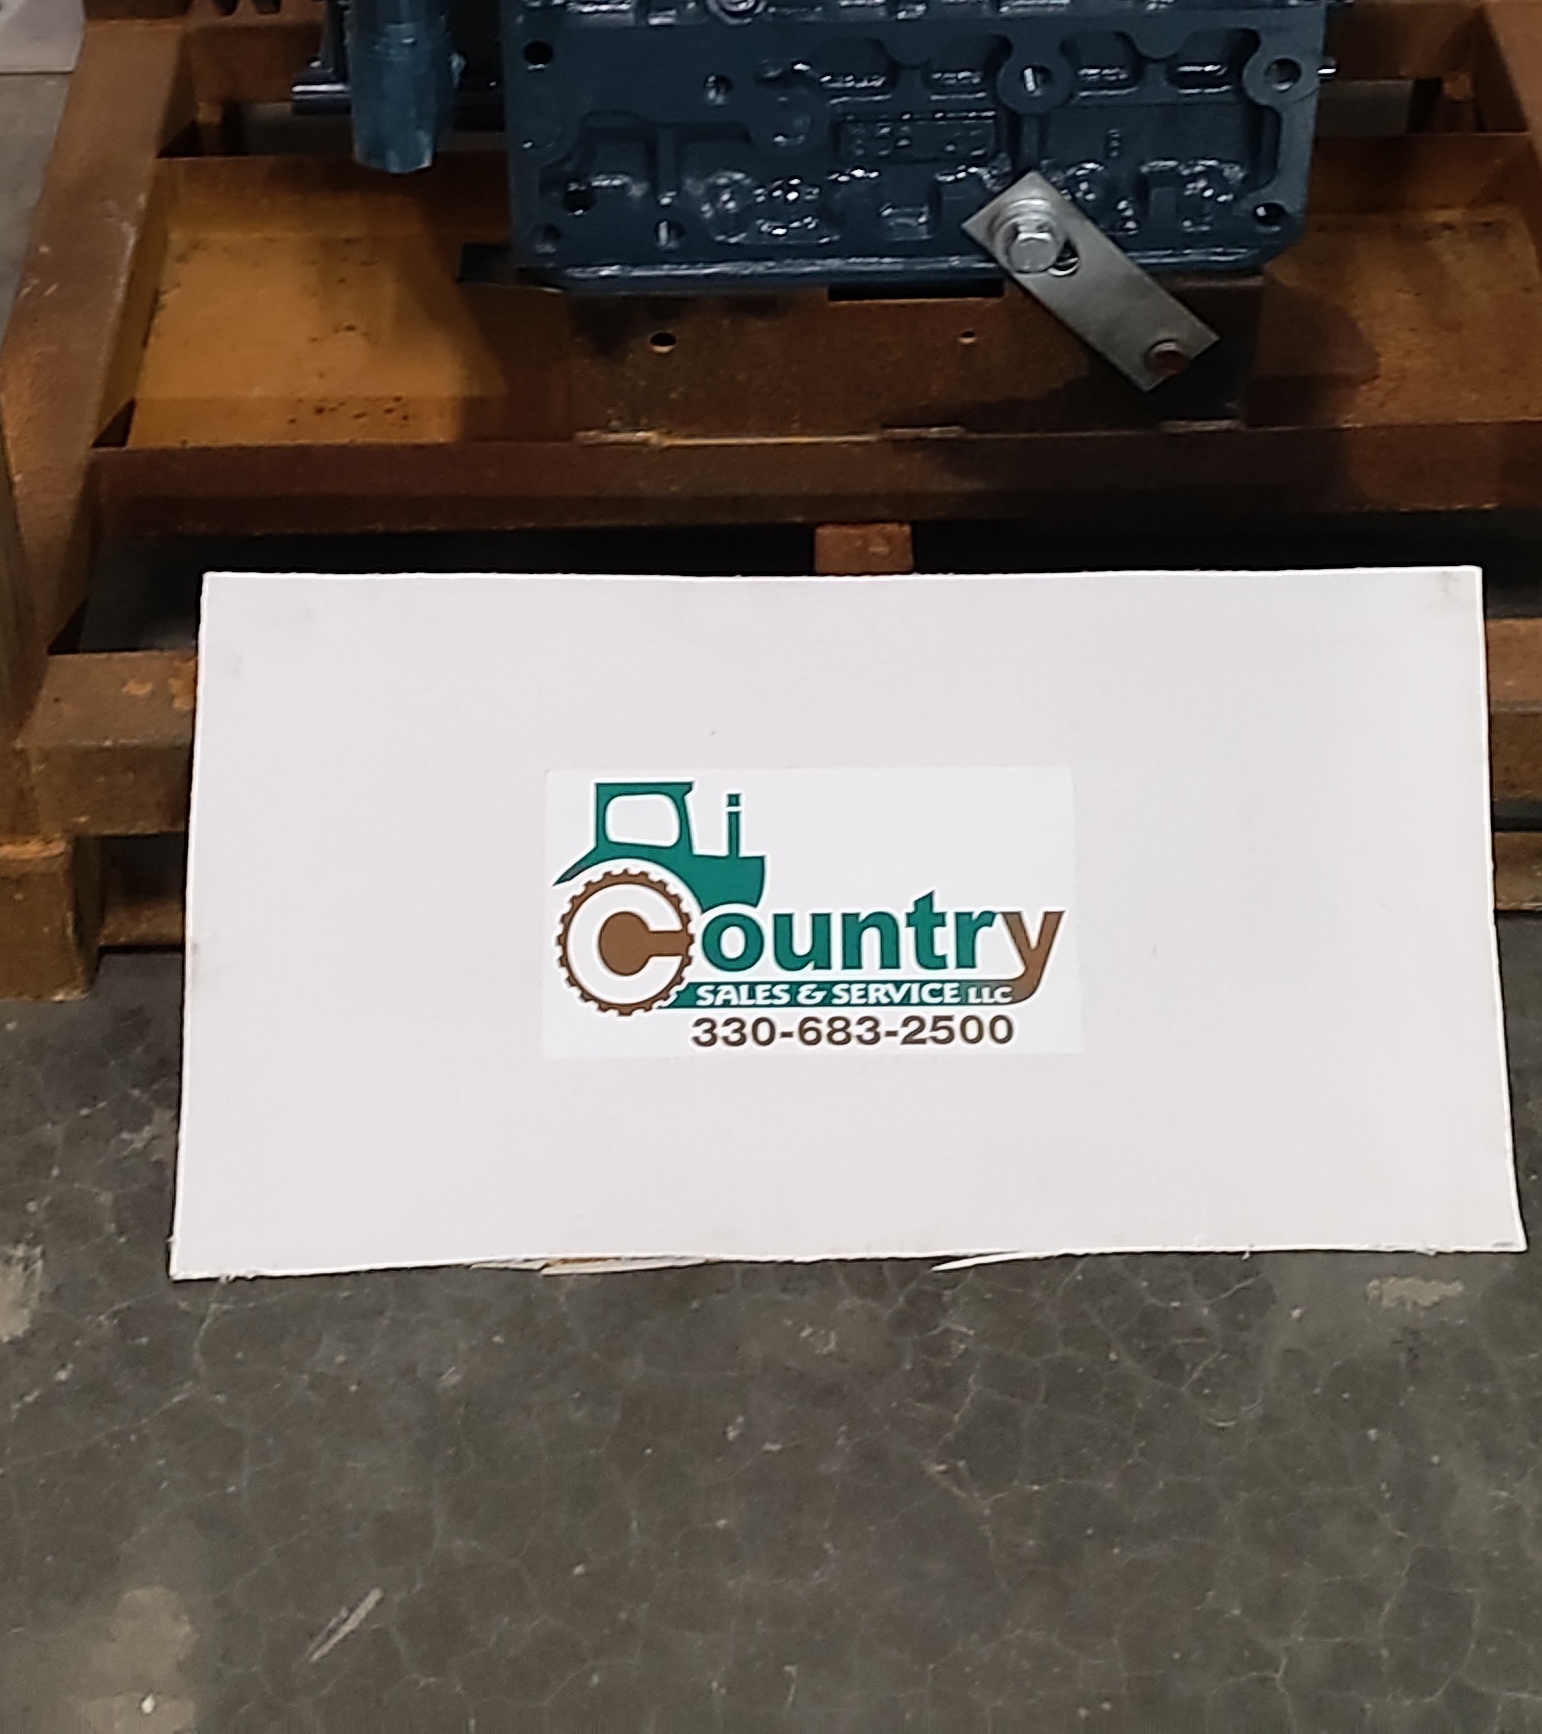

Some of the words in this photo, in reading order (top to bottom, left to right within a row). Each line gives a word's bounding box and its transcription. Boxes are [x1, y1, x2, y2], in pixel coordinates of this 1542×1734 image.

[563, 878, 1066, 1006] Country
[695, 984, 791, 1006] SALES
[797, 984, 826, 1005] &
[831, 982, 961, 1005] SERVICE
[967, 986, 1013, 1004] LLC
[691, 1014, 1015, 1047] 330-683-2500
